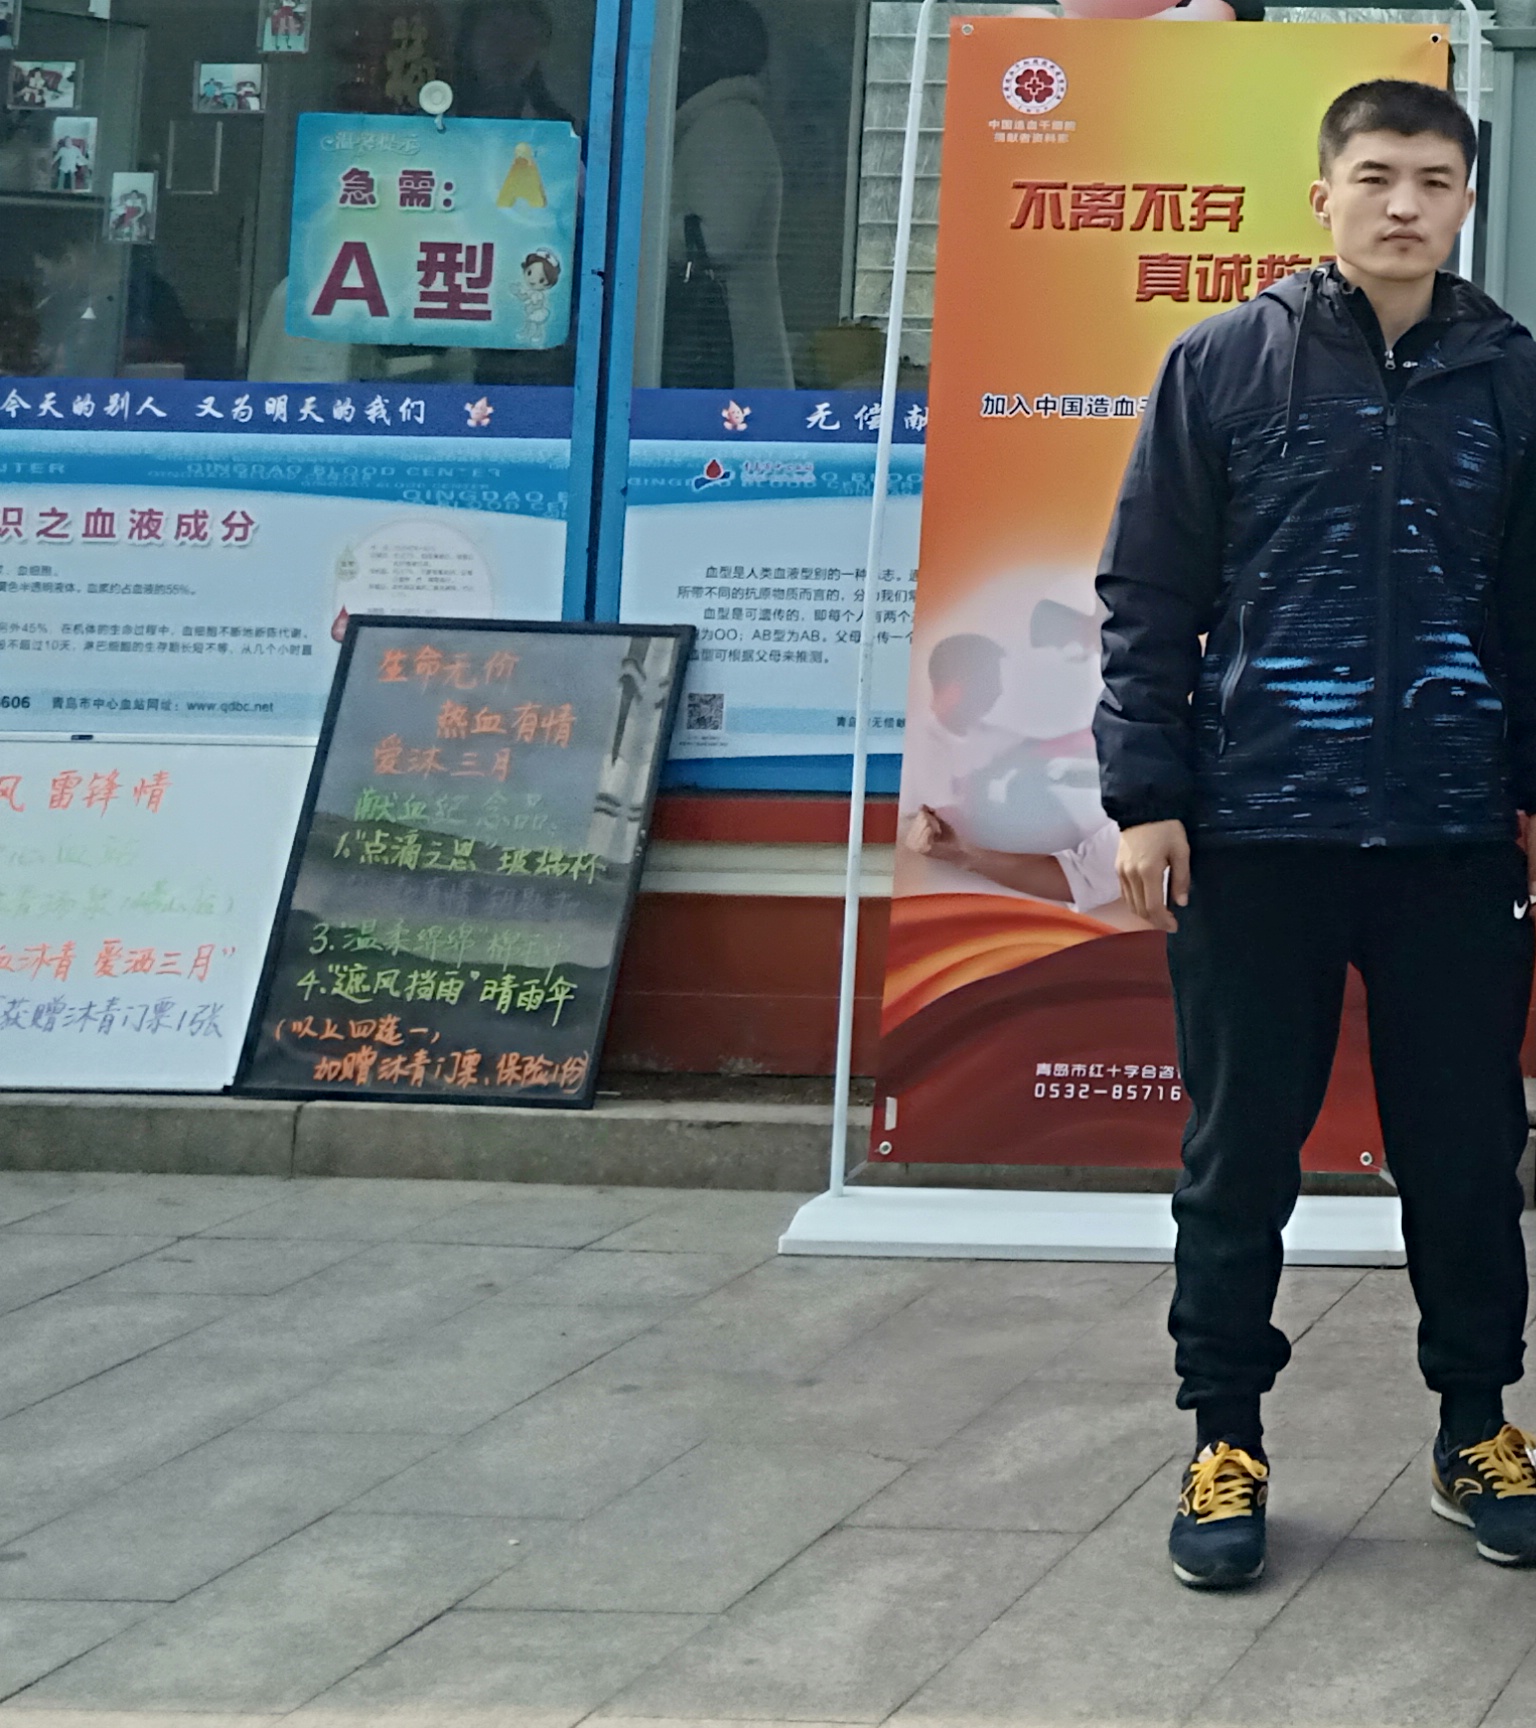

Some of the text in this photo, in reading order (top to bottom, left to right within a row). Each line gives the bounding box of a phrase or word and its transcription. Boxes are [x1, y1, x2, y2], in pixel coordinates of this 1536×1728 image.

[1009, 180, 1246, 232] 不离不弃
[1135, 253, 1337, 303] 真诚救
[436, 699, 577, 749] 热血有情
[1036, 1063, 1181, 1079] 青岛市红十字会咨
